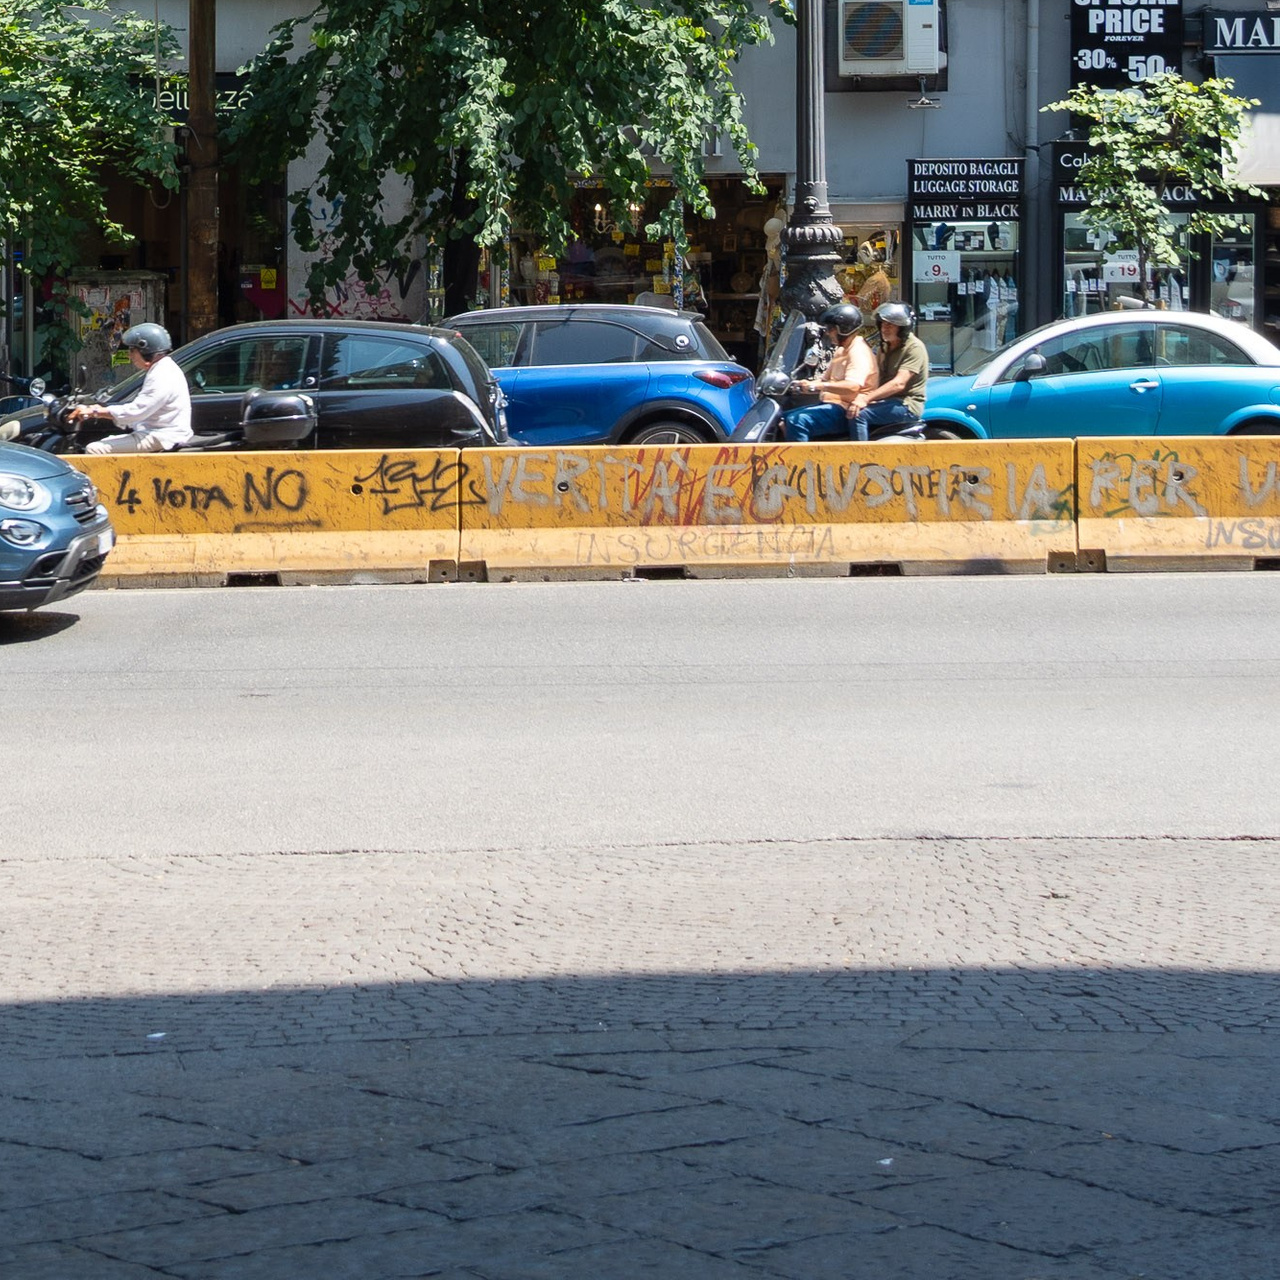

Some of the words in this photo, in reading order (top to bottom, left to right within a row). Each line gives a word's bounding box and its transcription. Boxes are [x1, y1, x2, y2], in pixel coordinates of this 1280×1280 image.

[1088, 8, 1164, 34] PRICE
[1073, 48, 1117, 70] -30%
[914, 162, 967, 175] DEPOSITO
[969, 162, 1019, 175] BAGAGLI
[913, 180, 966, 193] LUGGAGE
[968, 180, 1019, 192] STORAGE
[913, 205, 959, 218] MARRY
[962, 206, 974, 217] IN
[977, 204, 1019, 217] BLACK
[243, 467, 308, 513] NO
